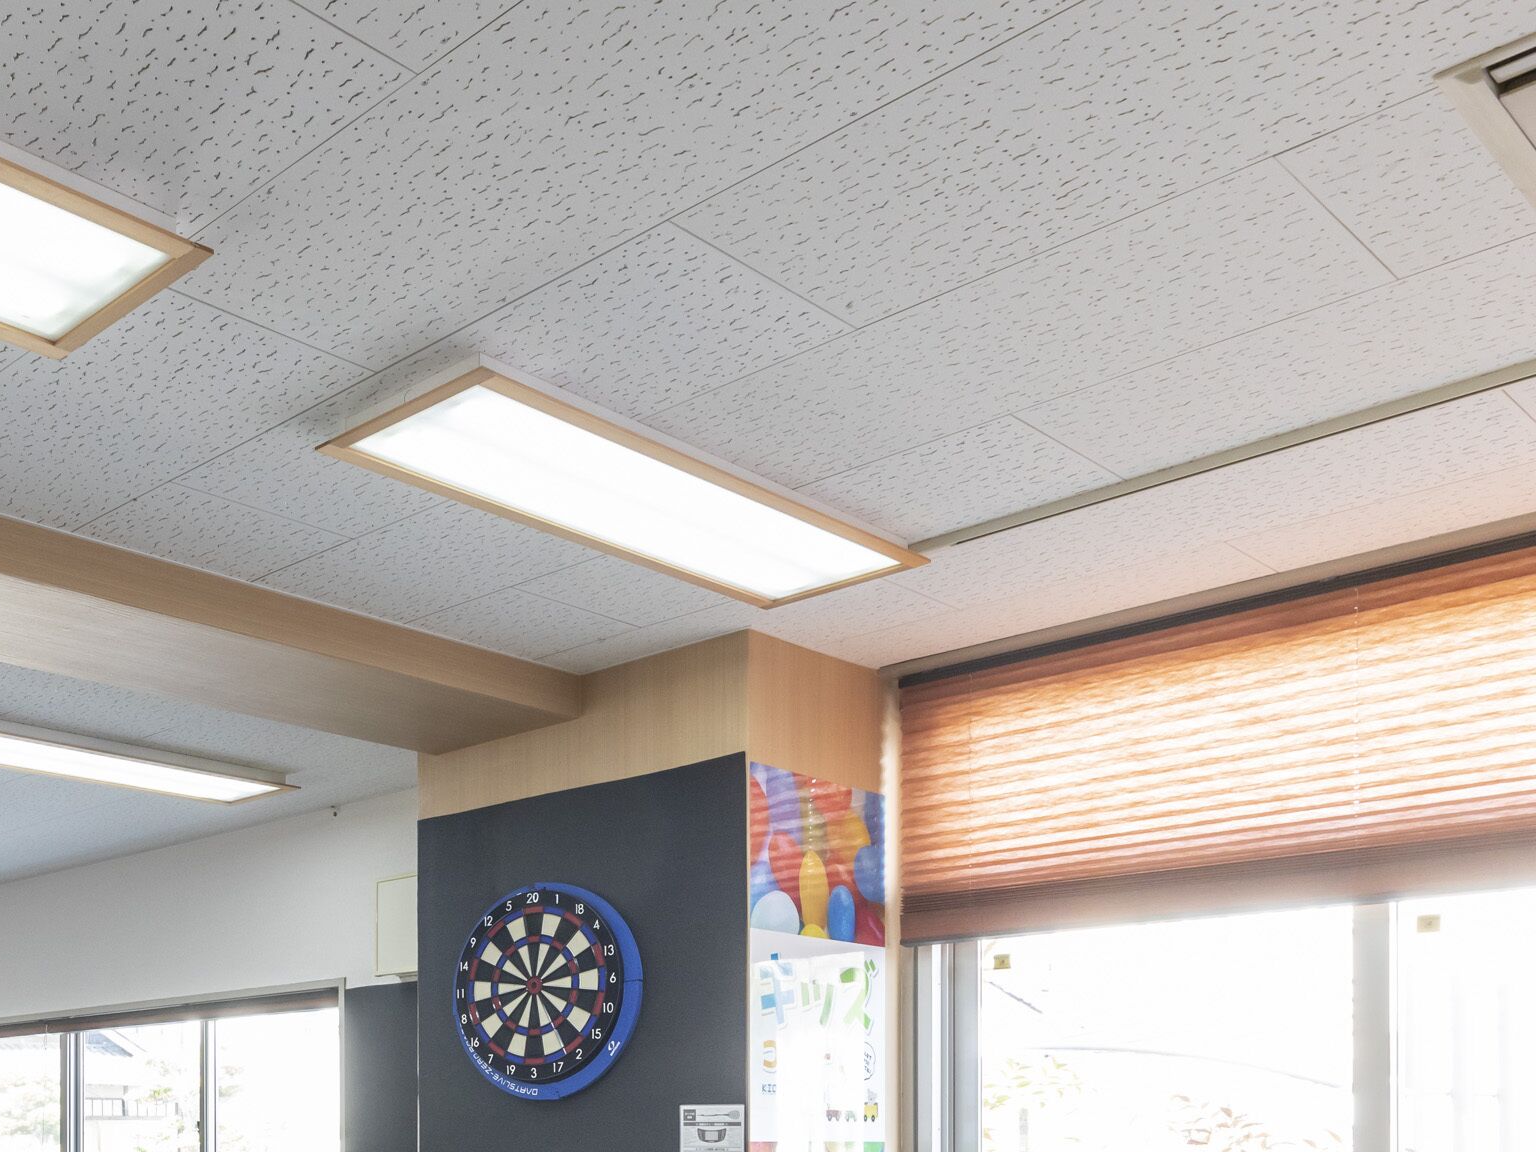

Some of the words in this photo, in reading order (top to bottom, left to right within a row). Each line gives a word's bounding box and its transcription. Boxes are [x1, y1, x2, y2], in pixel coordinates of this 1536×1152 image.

[526, 892, 539, 904] 20
[554, 894, 559, 904] 1
[506, 901, 513, 912] 5
[575, 904, 585, 915] 18
[484, 916, 493, 927] 12
[593, 920, 600, 930] 4
[470, 937, 477, 948] 9
[604, 944, 615, 956] 13
[459, 961, 469, 972] 14
[609, 972, 617, 983] 6
[456, 989, 465, 999] 11
[602, 1002, 614, 1013] 10
[461, 1014, 468, 1024] 8
[591, 1028, 602, 1039] 15
[470, 1038, 480, 1048] 16
[487, 1054, 494, 1064] 7
[575, 1049, 583, 1060] 2
[506, 1065, 516, 1075] 19
[552, 1062, 564, 1073] 17
[530, 1068, 538, 1079] 3
